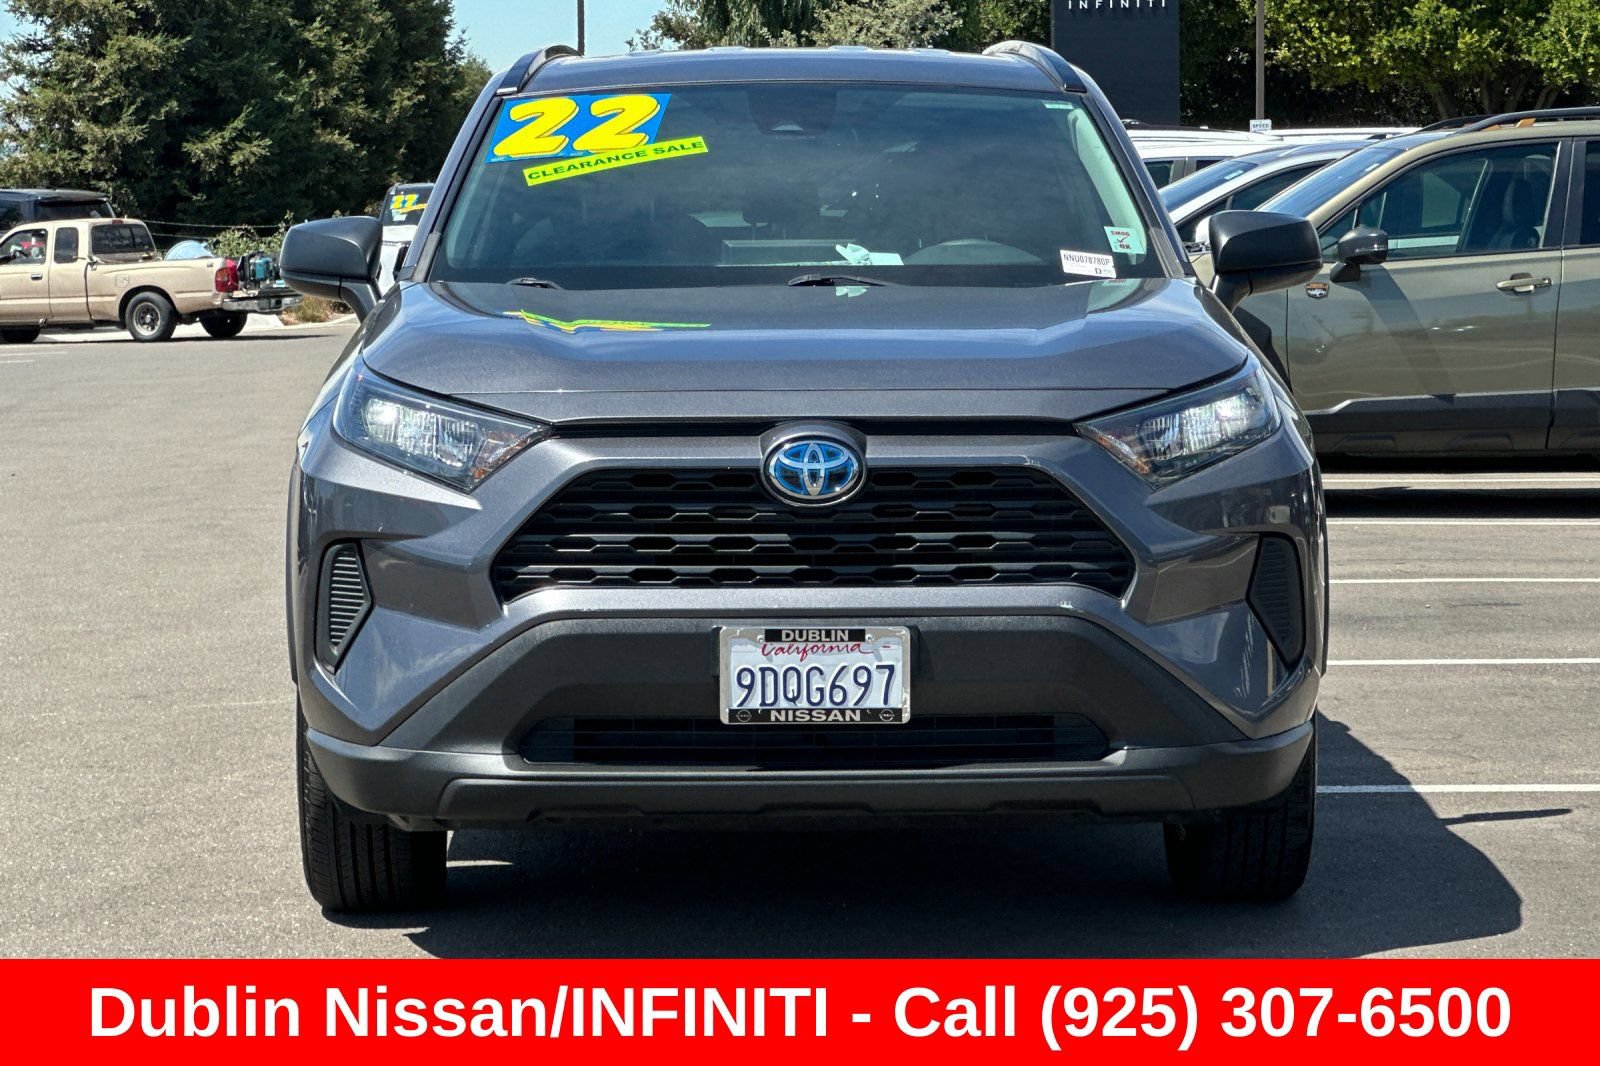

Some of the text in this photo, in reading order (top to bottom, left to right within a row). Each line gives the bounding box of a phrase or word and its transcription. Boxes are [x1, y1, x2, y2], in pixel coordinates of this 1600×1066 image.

[1068, 0, 1166, 9] INFINITI
[493, 94, 660, 158] 22
[527, 140, 705, 180] CLEARANCE SALE
[781, 629, 849, 642] DUBLIN
[761, 642, 875, 662] California
[736, 664, 895, 707] 9DQG697
[770, 709, 861, 722] NISSAN
